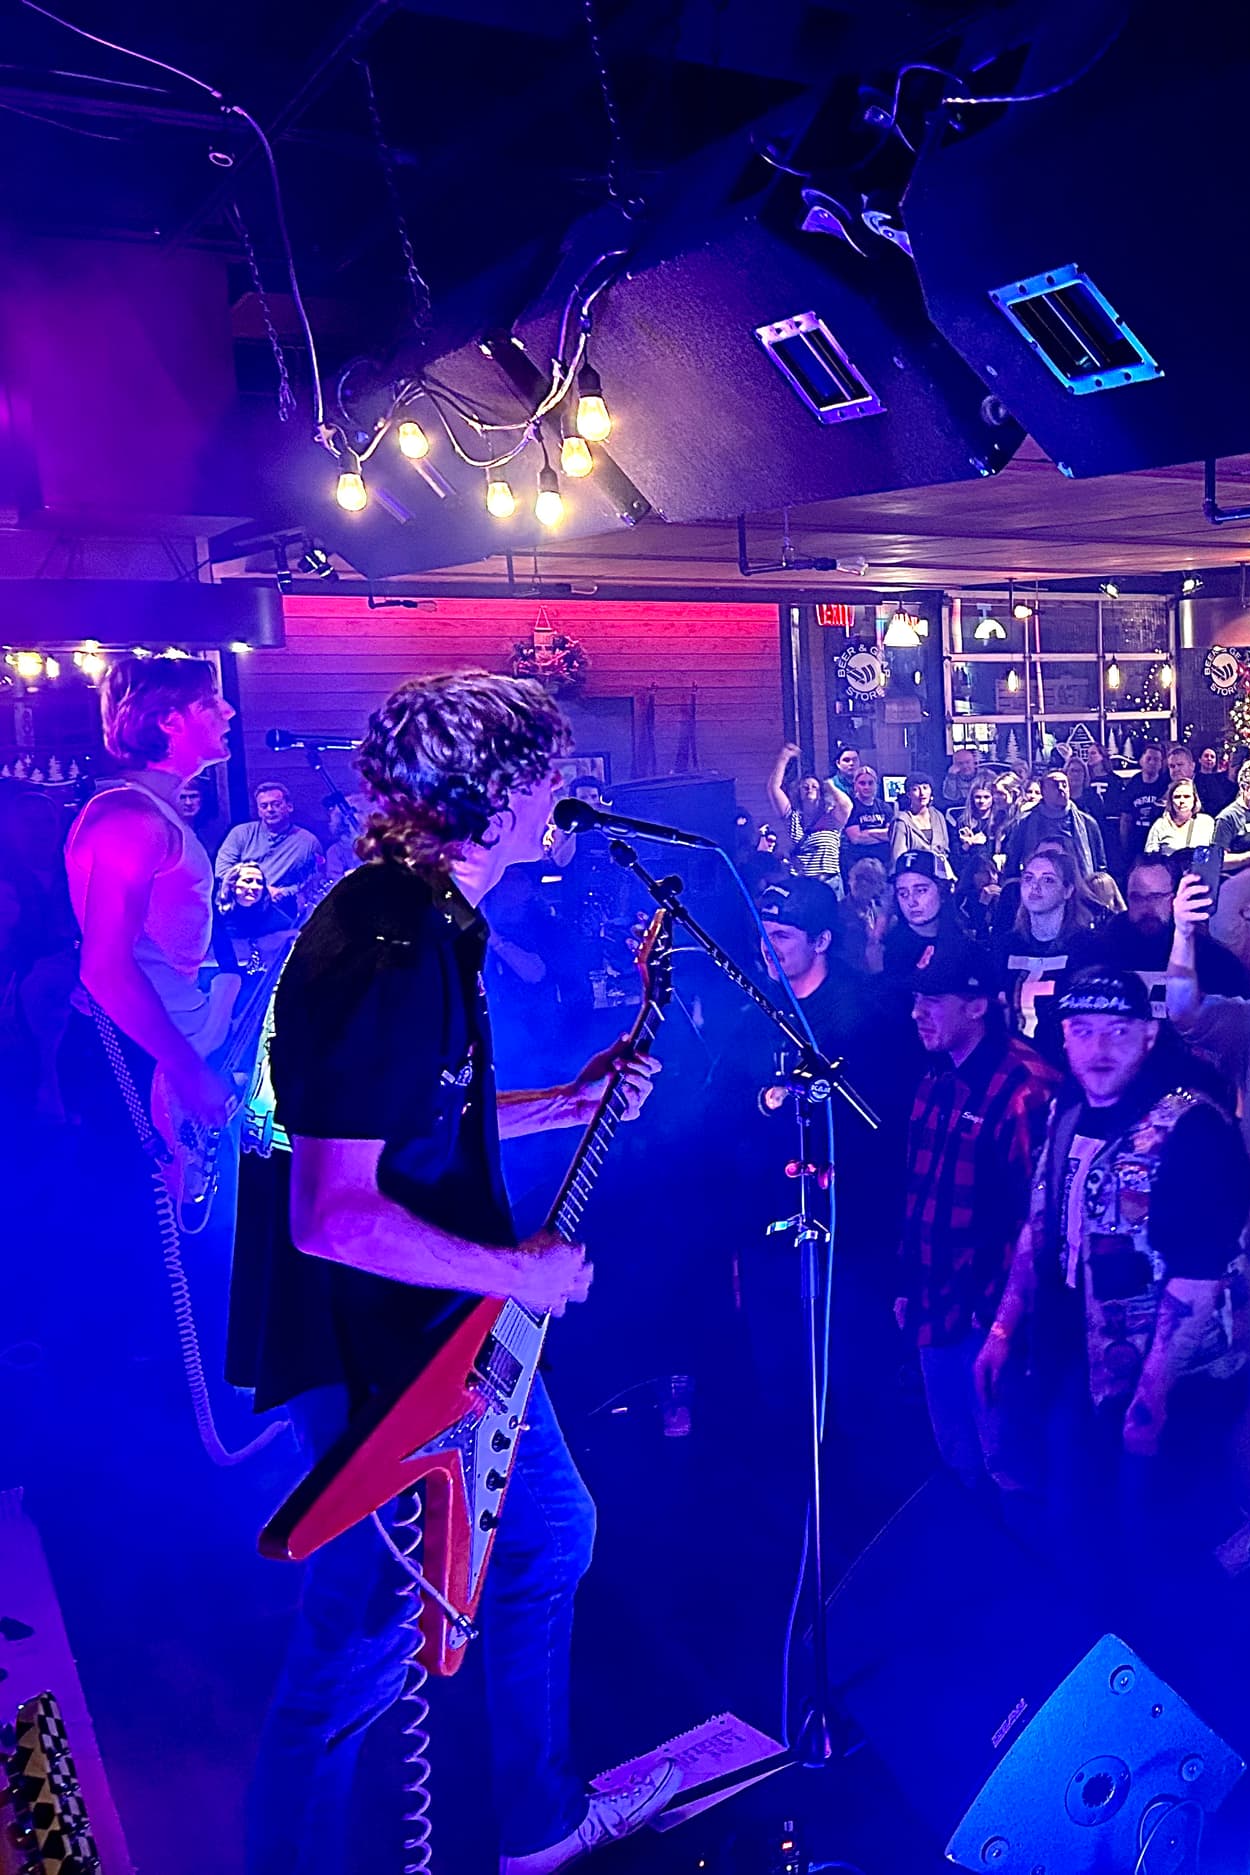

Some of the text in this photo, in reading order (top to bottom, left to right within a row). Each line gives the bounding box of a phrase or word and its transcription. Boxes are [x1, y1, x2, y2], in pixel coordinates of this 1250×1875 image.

[837, 646, 856, 678] BEER
[858, 644, 867, 652] &
[846, 686, 885, 701] STORE
